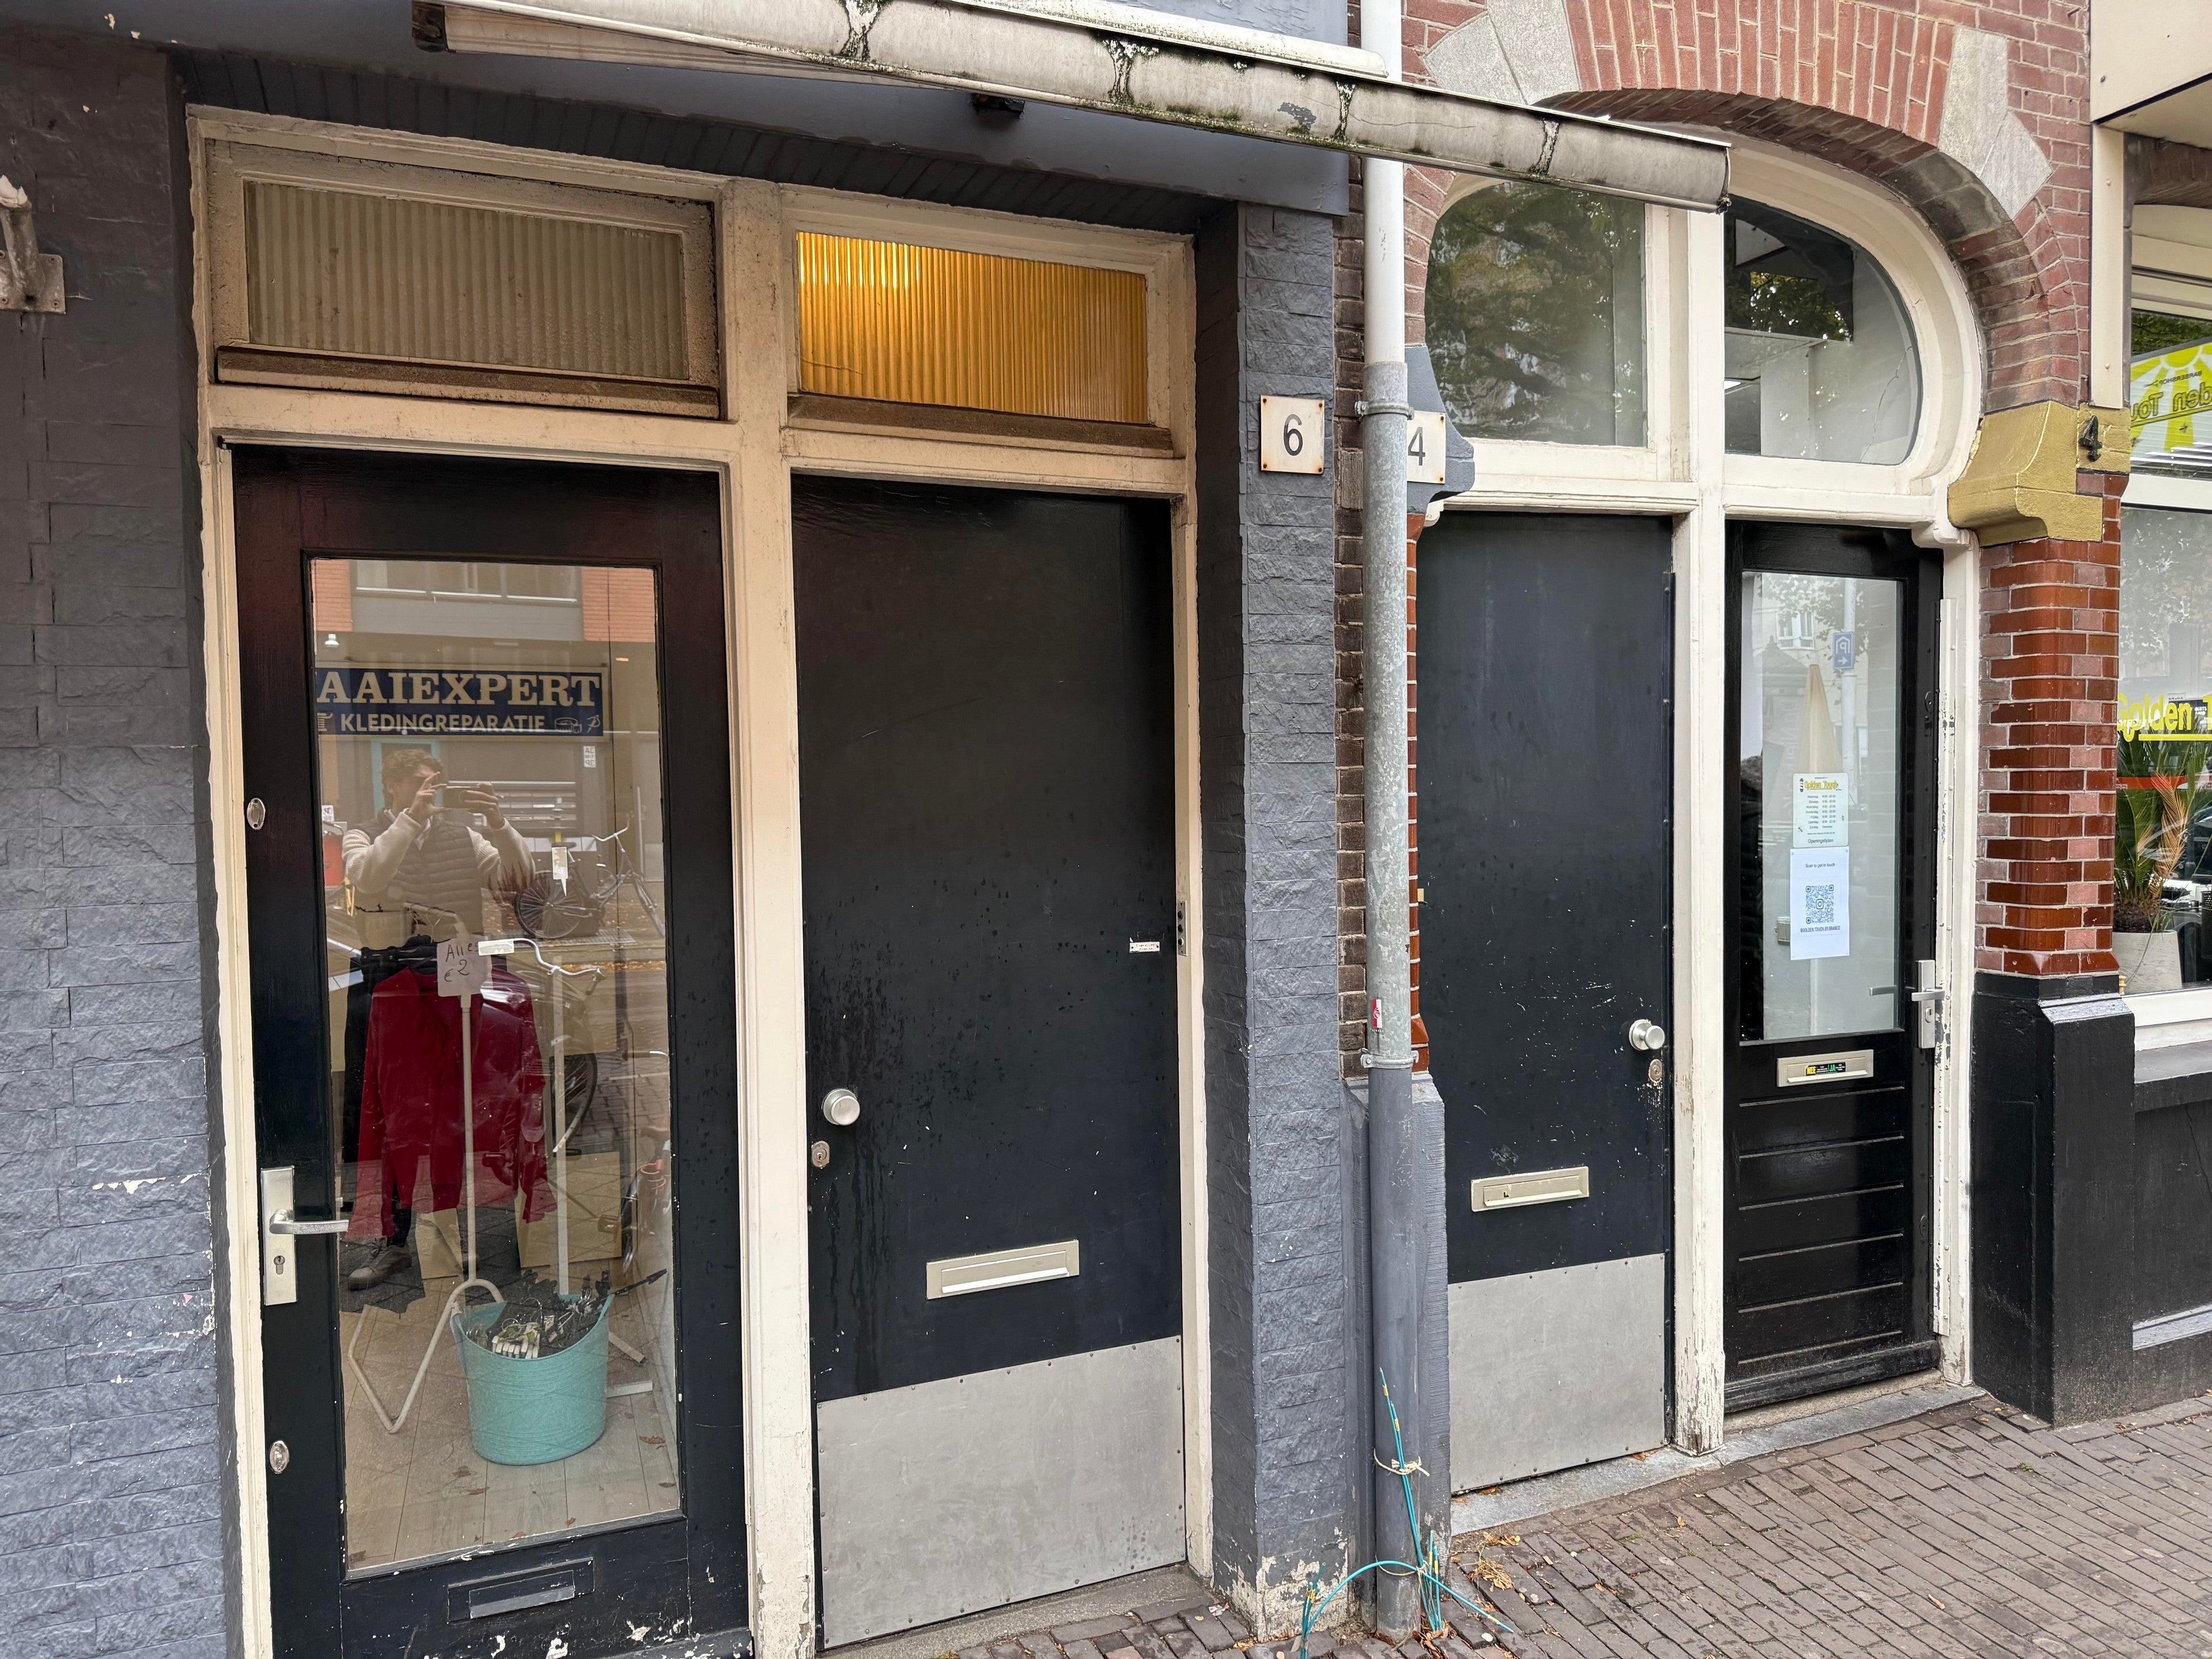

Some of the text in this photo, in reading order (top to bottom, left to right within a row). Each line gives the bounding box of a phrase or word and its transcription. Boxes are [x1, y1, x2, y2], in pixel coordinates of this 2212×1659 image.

[1283, 414, 1304, 456] 6
[1407, 426, 1426, 466] 4
[316, 671, 600, 707] AAIEXPERT
[340, 713, 545, 733] KLEDINGREPARATIE
[1807, 1066, 1816, 1074] NEE
